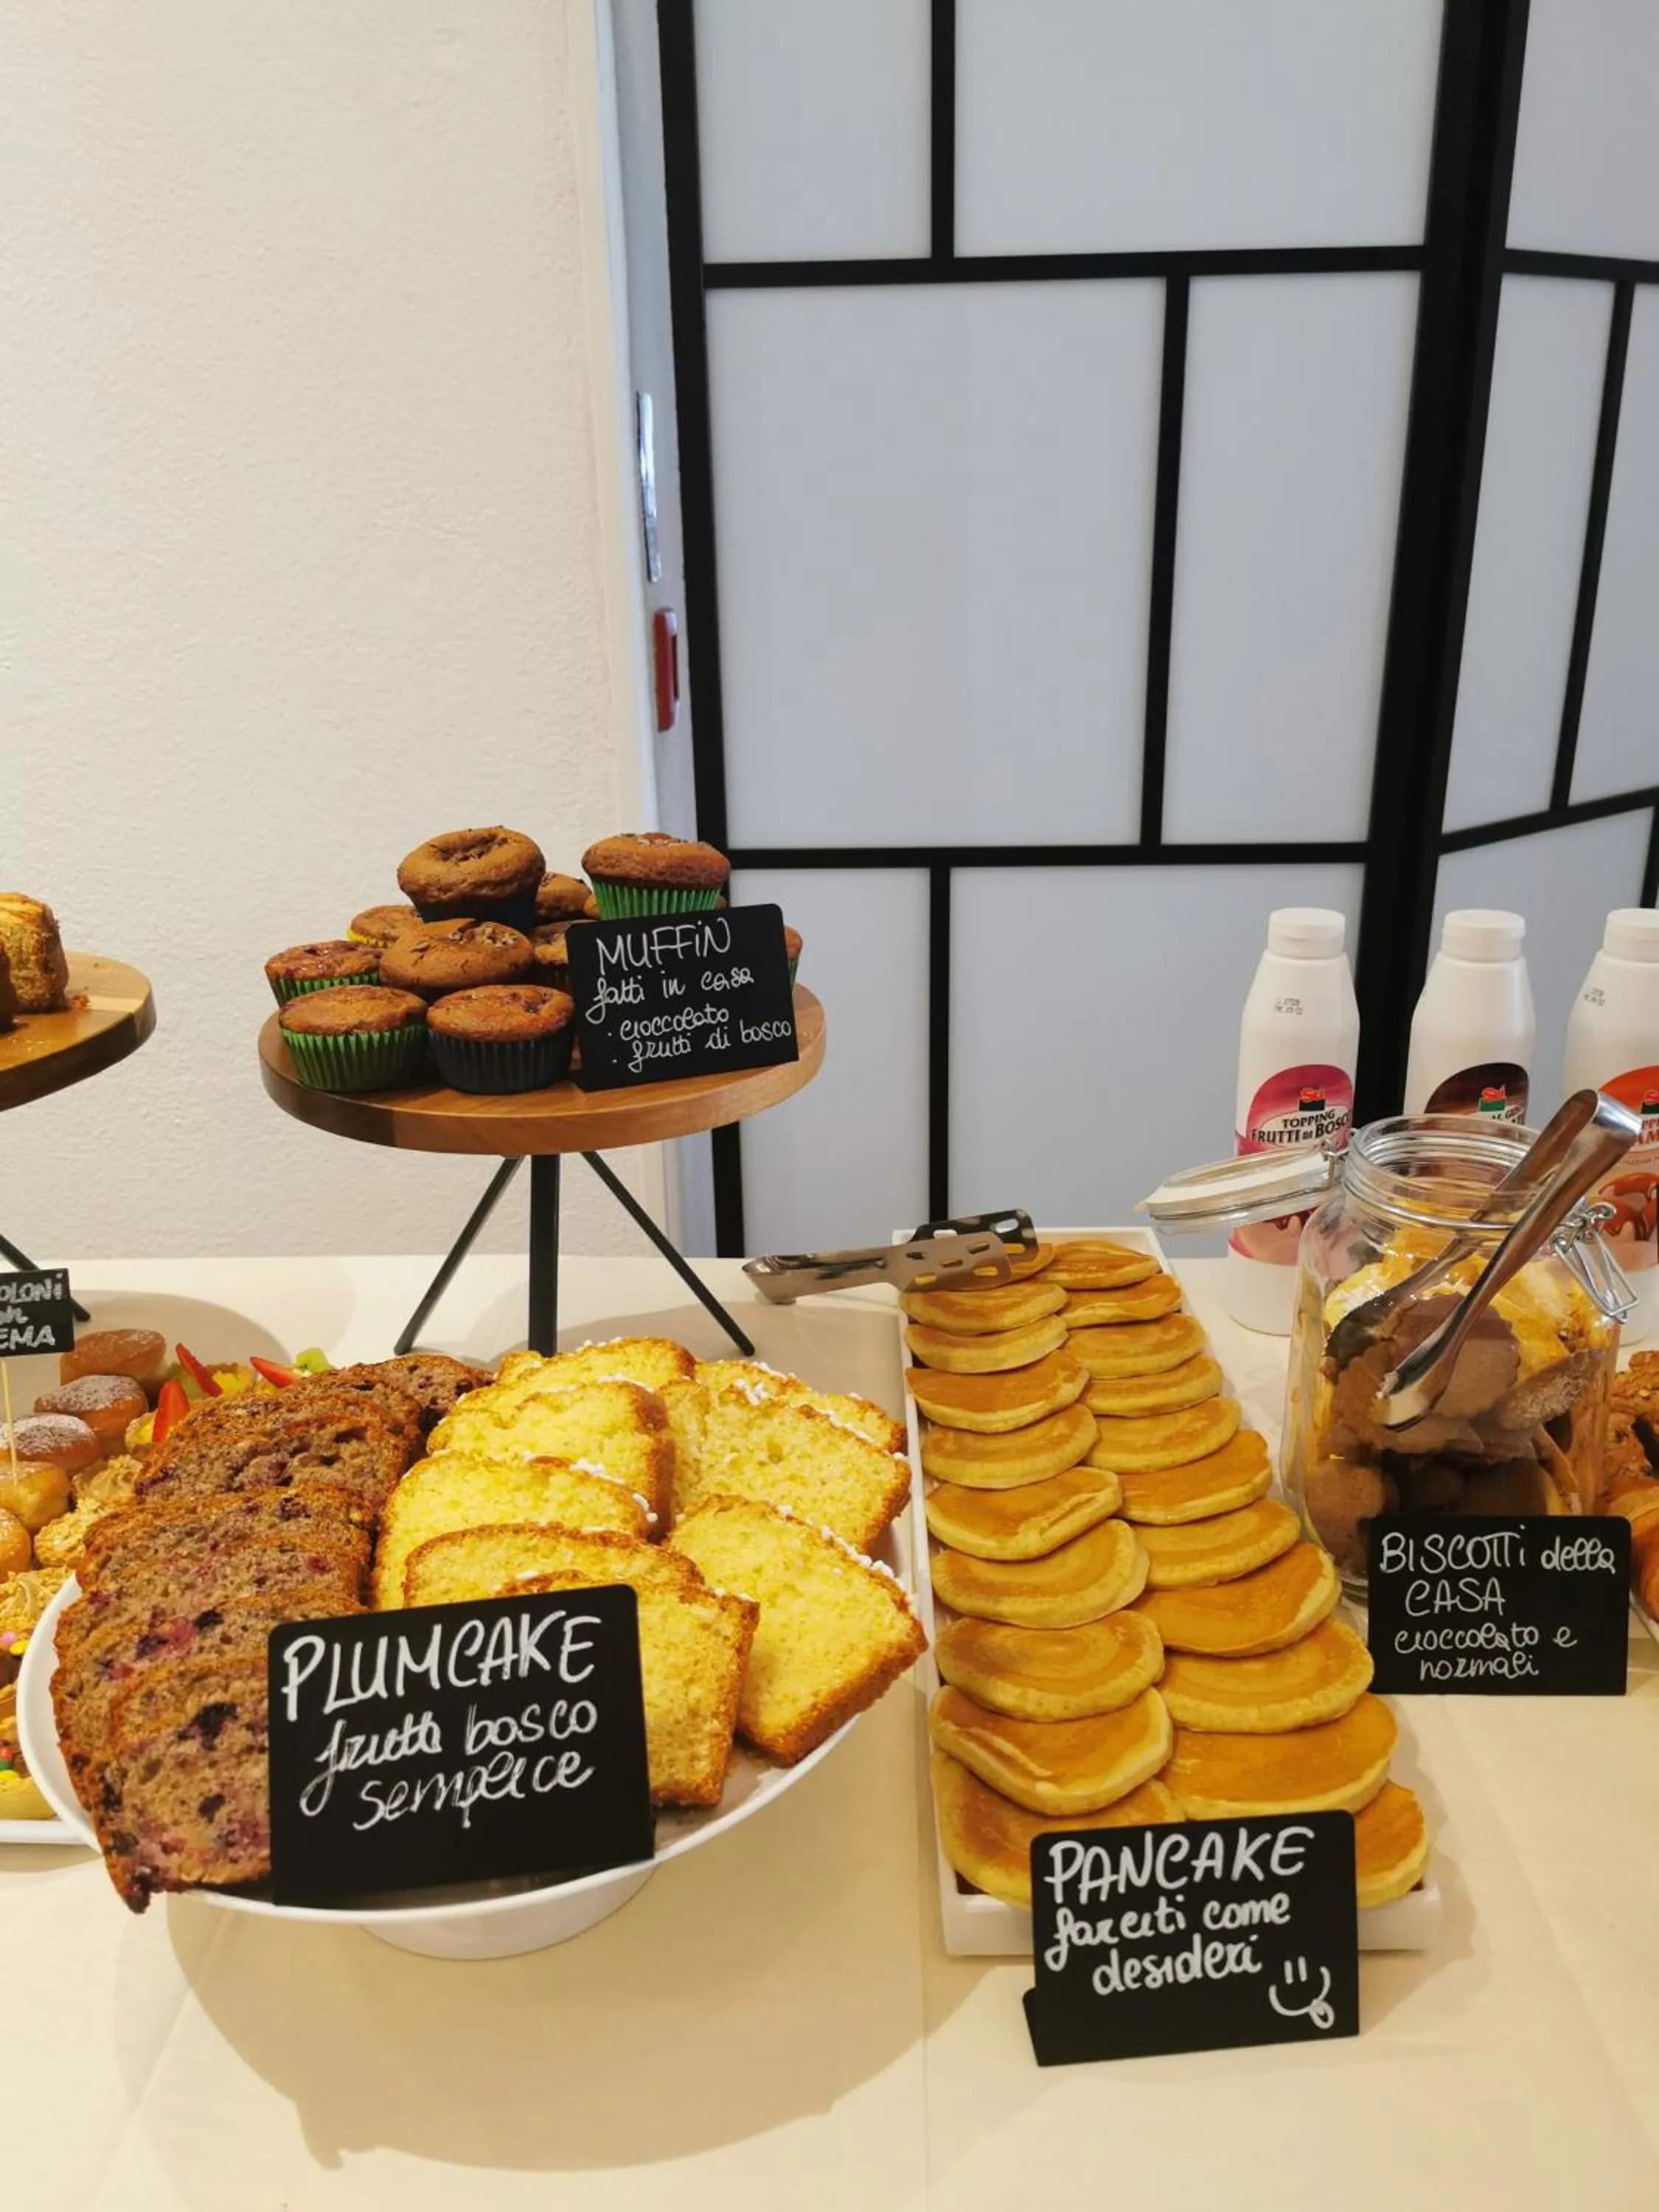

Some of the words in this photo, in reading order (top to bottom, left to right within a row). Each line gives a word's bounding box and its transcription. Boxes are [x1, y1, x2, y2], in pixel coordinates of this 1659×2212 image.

[585, 975, 645, 1024] fatti
[661, 970, 686, 999] in
[700, 967, 754, 992] casa
[619, 1003, 729, 1041] cioccolato
[627, 1033, 692, 1074] frutti
[705, 1026, 731, 1050] di
[740, 1020, 791, 1043] bosco
[1251, 1129, 1301, 1143] FRUTTI
[1282, 1109, 1335, 1129] TOPPING
[1540, 1536, 1616, 1575] della
[1405, 1576, 1506, 1617] CASA
[1394, 1622, 1540, 1654] cioccolato
[1552, 1626, 1579, 1648] e
[281, 1610, 603, 1722] PLUMCAKE
[1419, 1651, 1540, 1682] normali
[465, 1699, 599, 1756] bosco
[352, 1750, 595, 1832] semplice
[1043, 1826, 1315, 1905] PANCAKE
[1203, 1891, 1292, 1931] come
[1092, 1933, 1263, 1996] desideri
